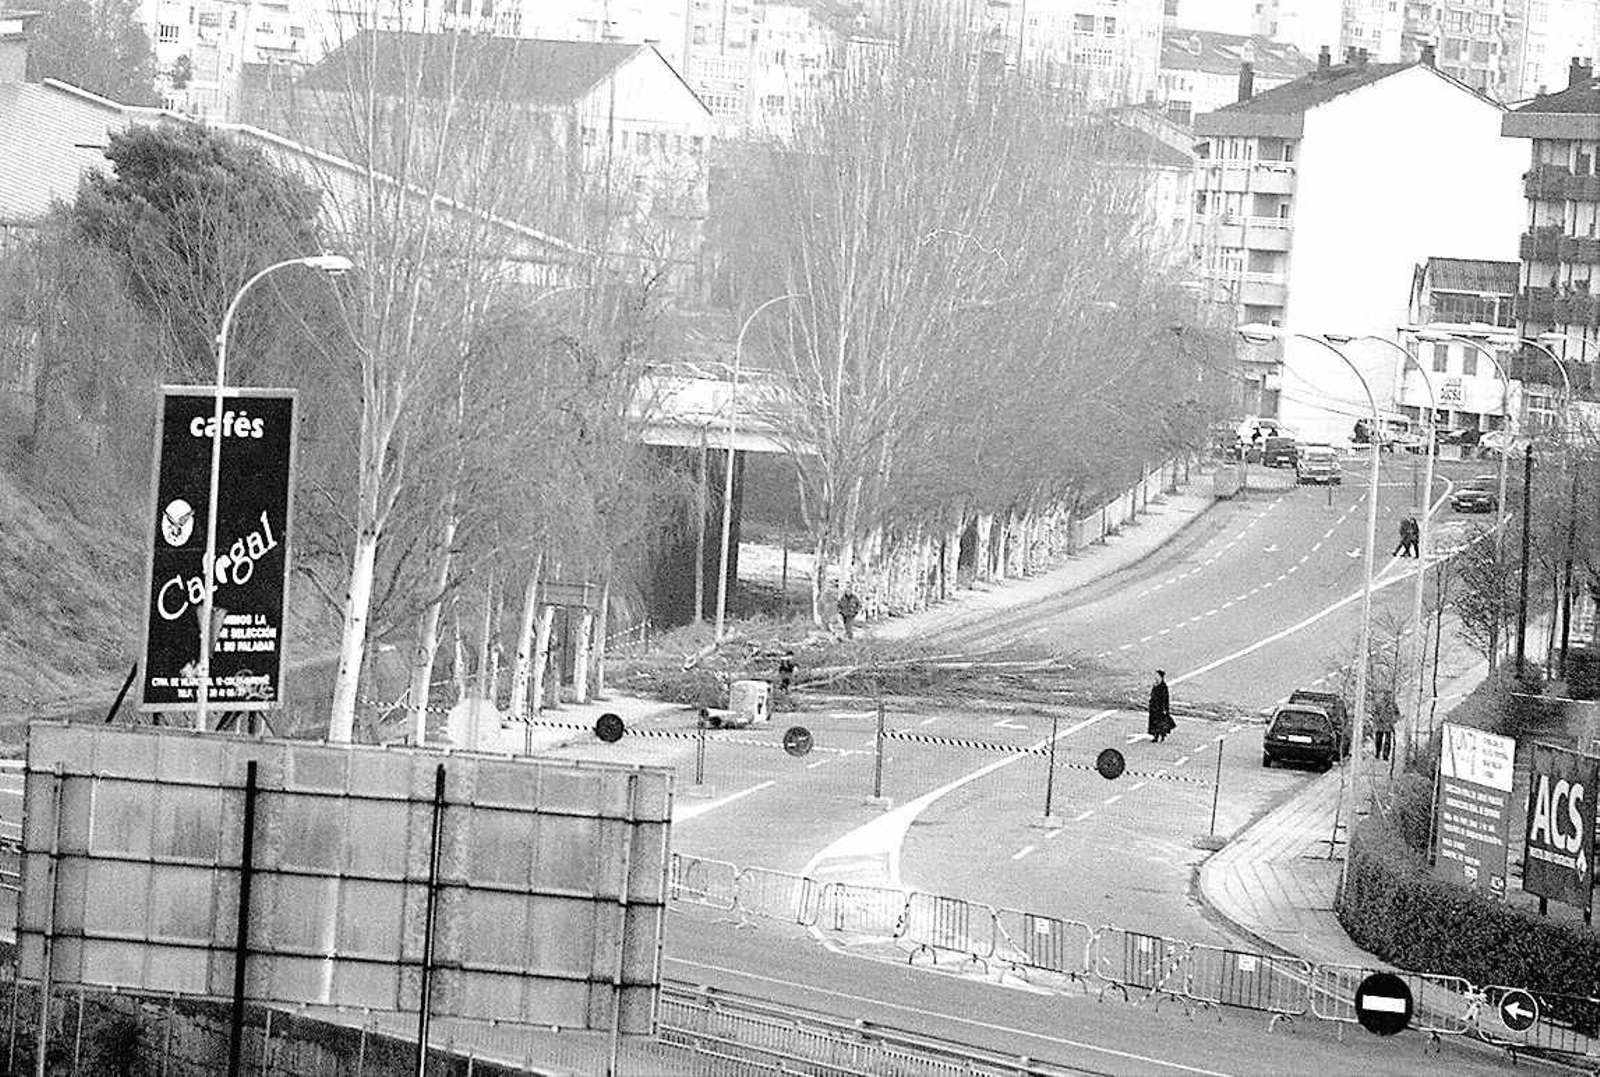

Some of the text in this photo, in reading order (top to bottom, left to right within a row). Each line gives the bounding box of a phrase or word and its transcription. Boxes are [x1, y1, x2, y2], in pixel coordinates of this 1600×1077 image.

[190, 411, 264, 438] cafés
[254, 613, 267, 626] LA
[237, 640, 275, 652] PALADAR
[1530, 775, 1584, 853] ACS
